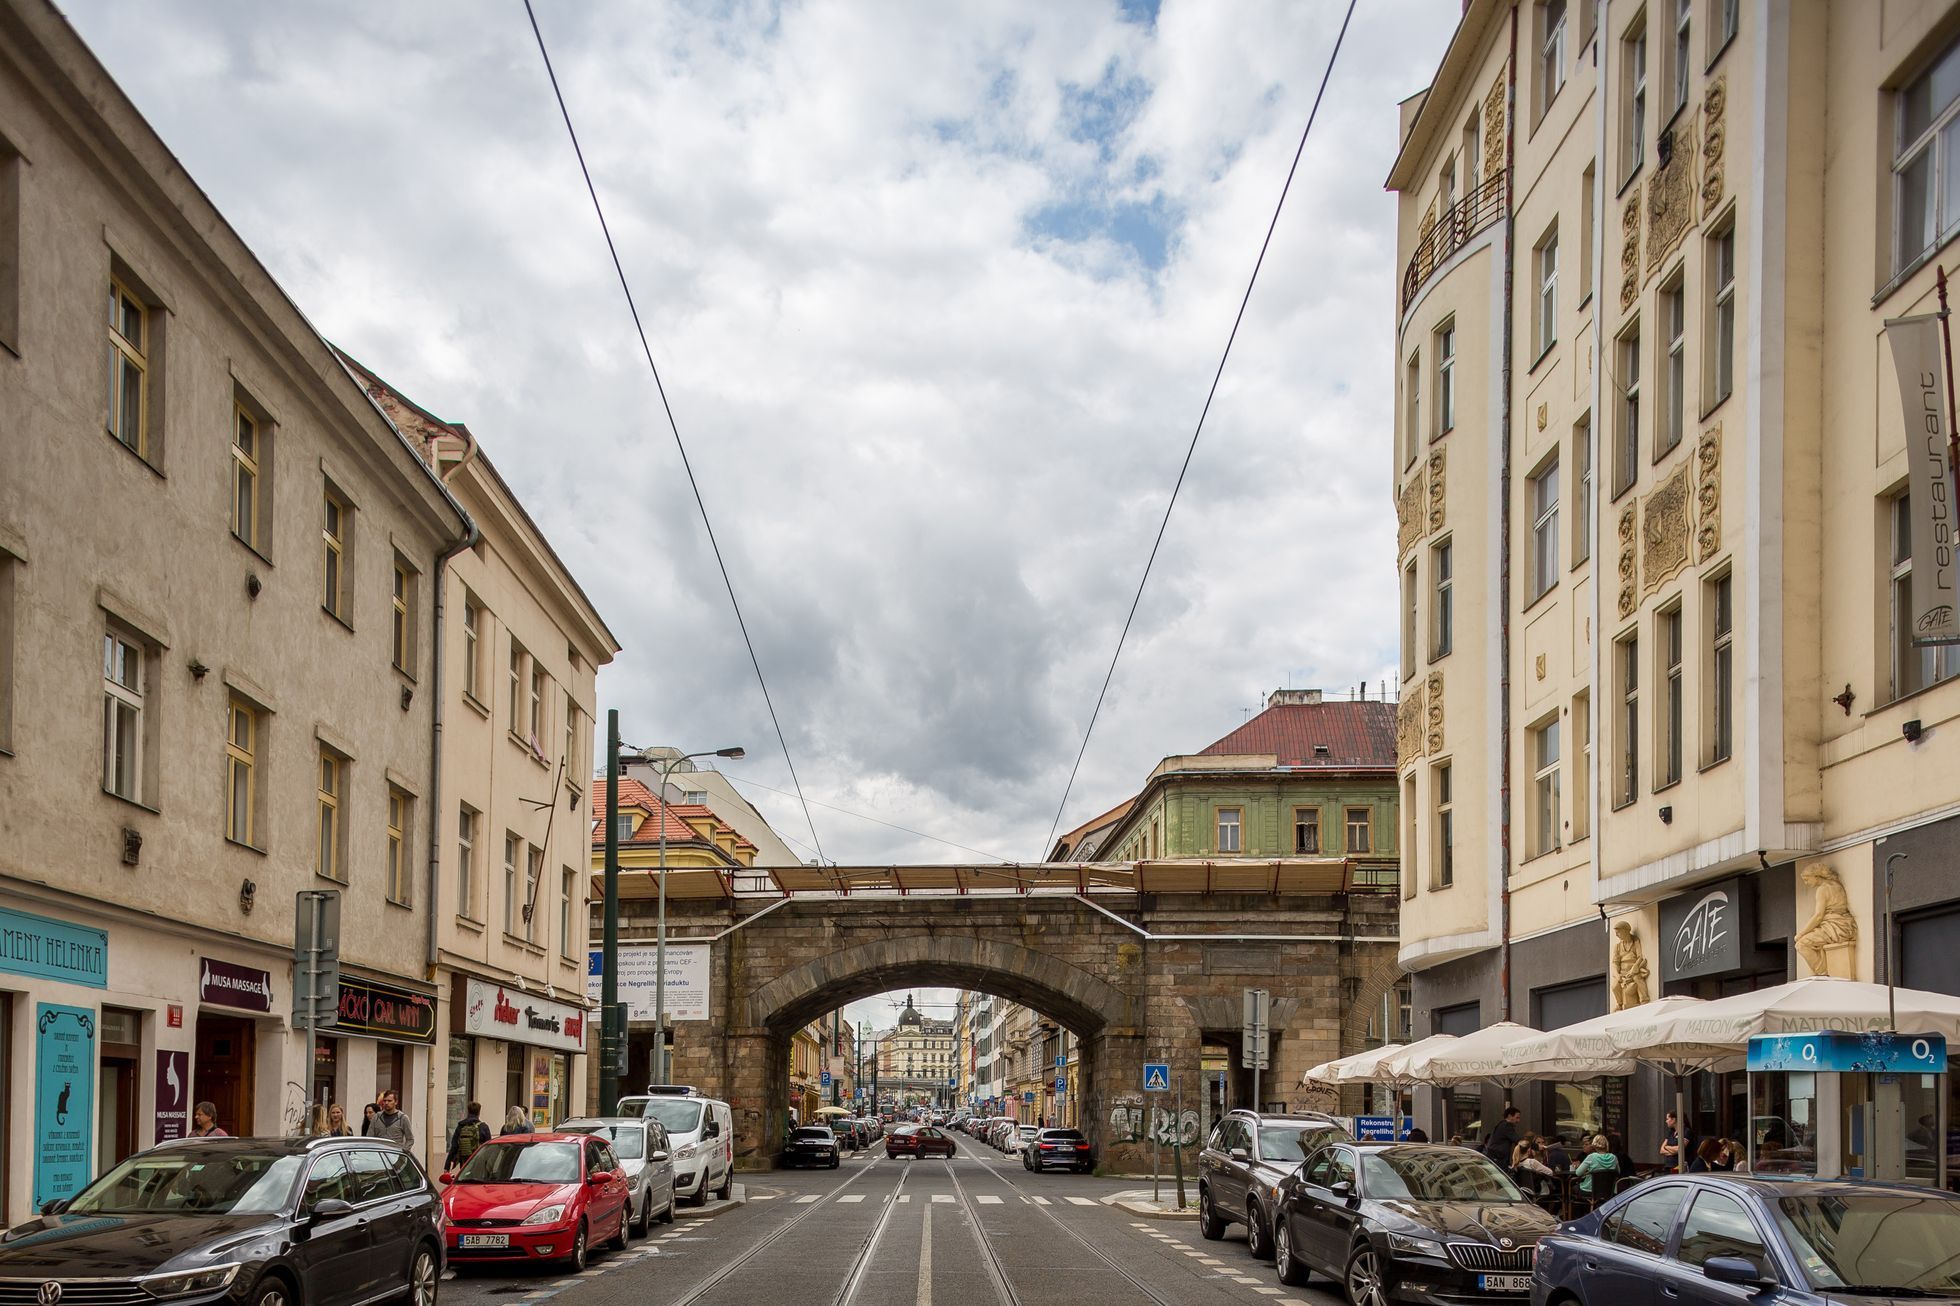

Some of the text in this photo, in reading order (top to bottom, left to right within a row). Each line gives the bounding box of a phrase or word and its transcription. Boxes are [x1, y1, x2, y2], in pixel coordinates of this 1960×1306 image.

[1920, 372, 1951, 590] restaurant
[0, 928, 102, 974] MENY HELENKA
[211, 974, 262, 994] MUSA MASSAGE
[628, 980, 657, 989] Negrellih
[1686, 1019, 1733, 1034] MATTONI
[1781, 1016, 1864, 1033] MATTONI
[1573, 1037, 1612, 1051] MATTON
[1440, 1060, 1494, 1071] MATTONI
[465, 1236, 506, 1244] 5AB 7782
[1486, 1277, 1530, 1288] 5AN 868
